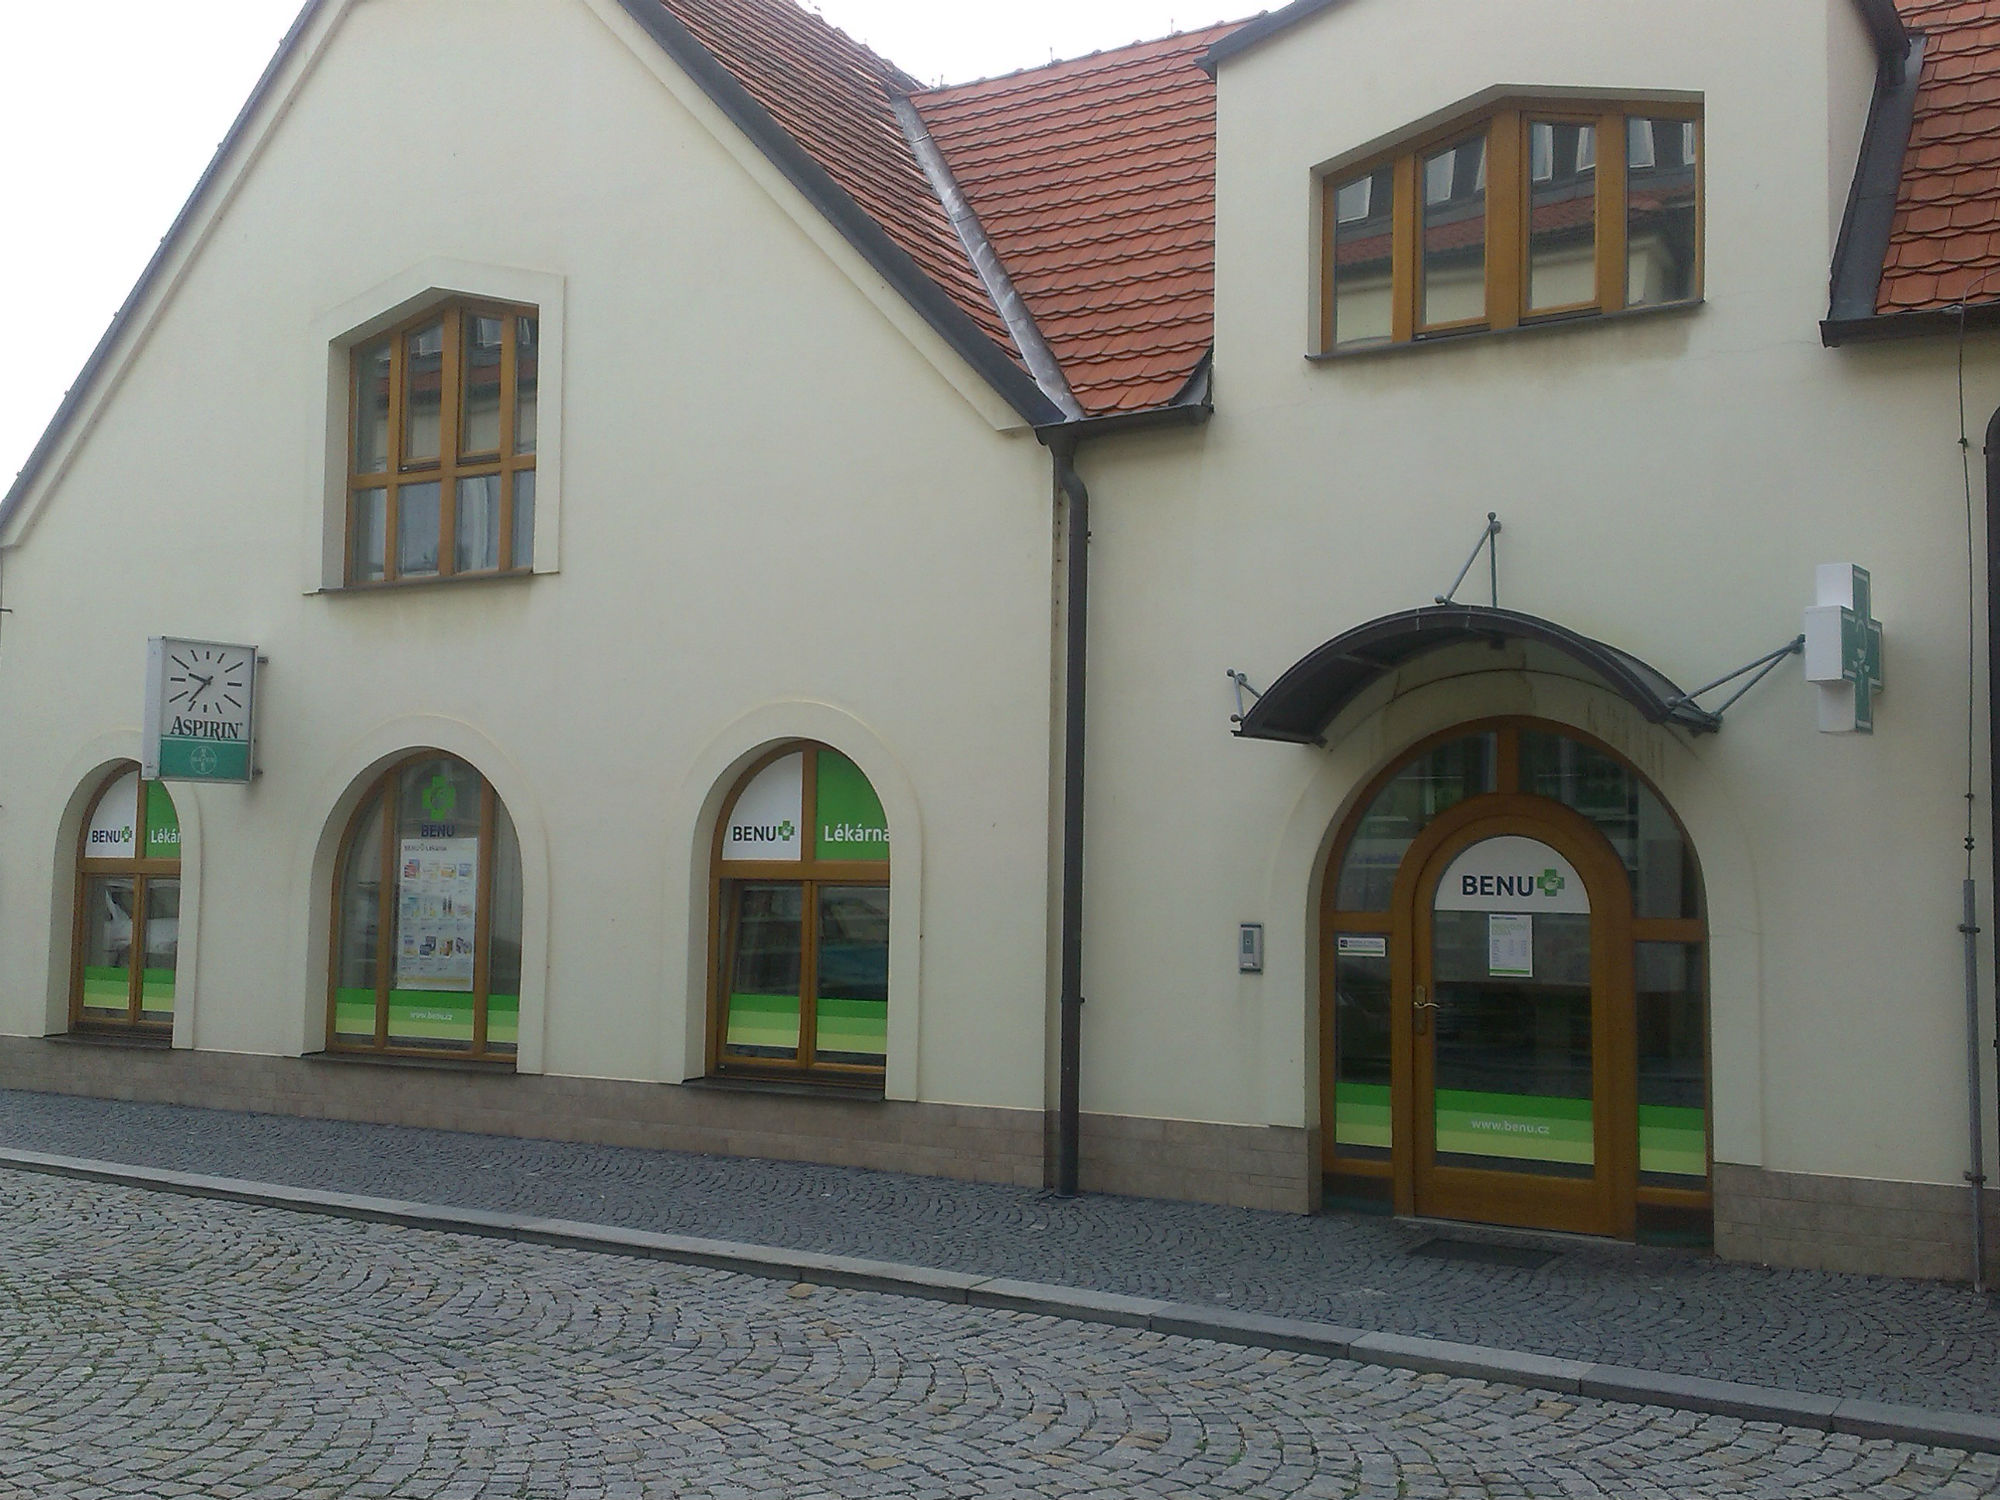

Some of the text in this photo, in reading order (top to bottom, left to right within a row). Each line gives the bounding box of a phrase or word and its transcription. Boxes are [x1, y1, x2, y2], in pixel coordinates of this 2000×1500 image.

[170, 715, 239, 741] ASPIRIN
[92, 829, 181, 843] BENU Lékár
[421, 824, 454, 837] BENU
[732, 823, 891, 842] BENU Lékárna
[1462, 875, 1534, 897] BENU
[1471, 1119, 1550, 1134] www.benu.cz
